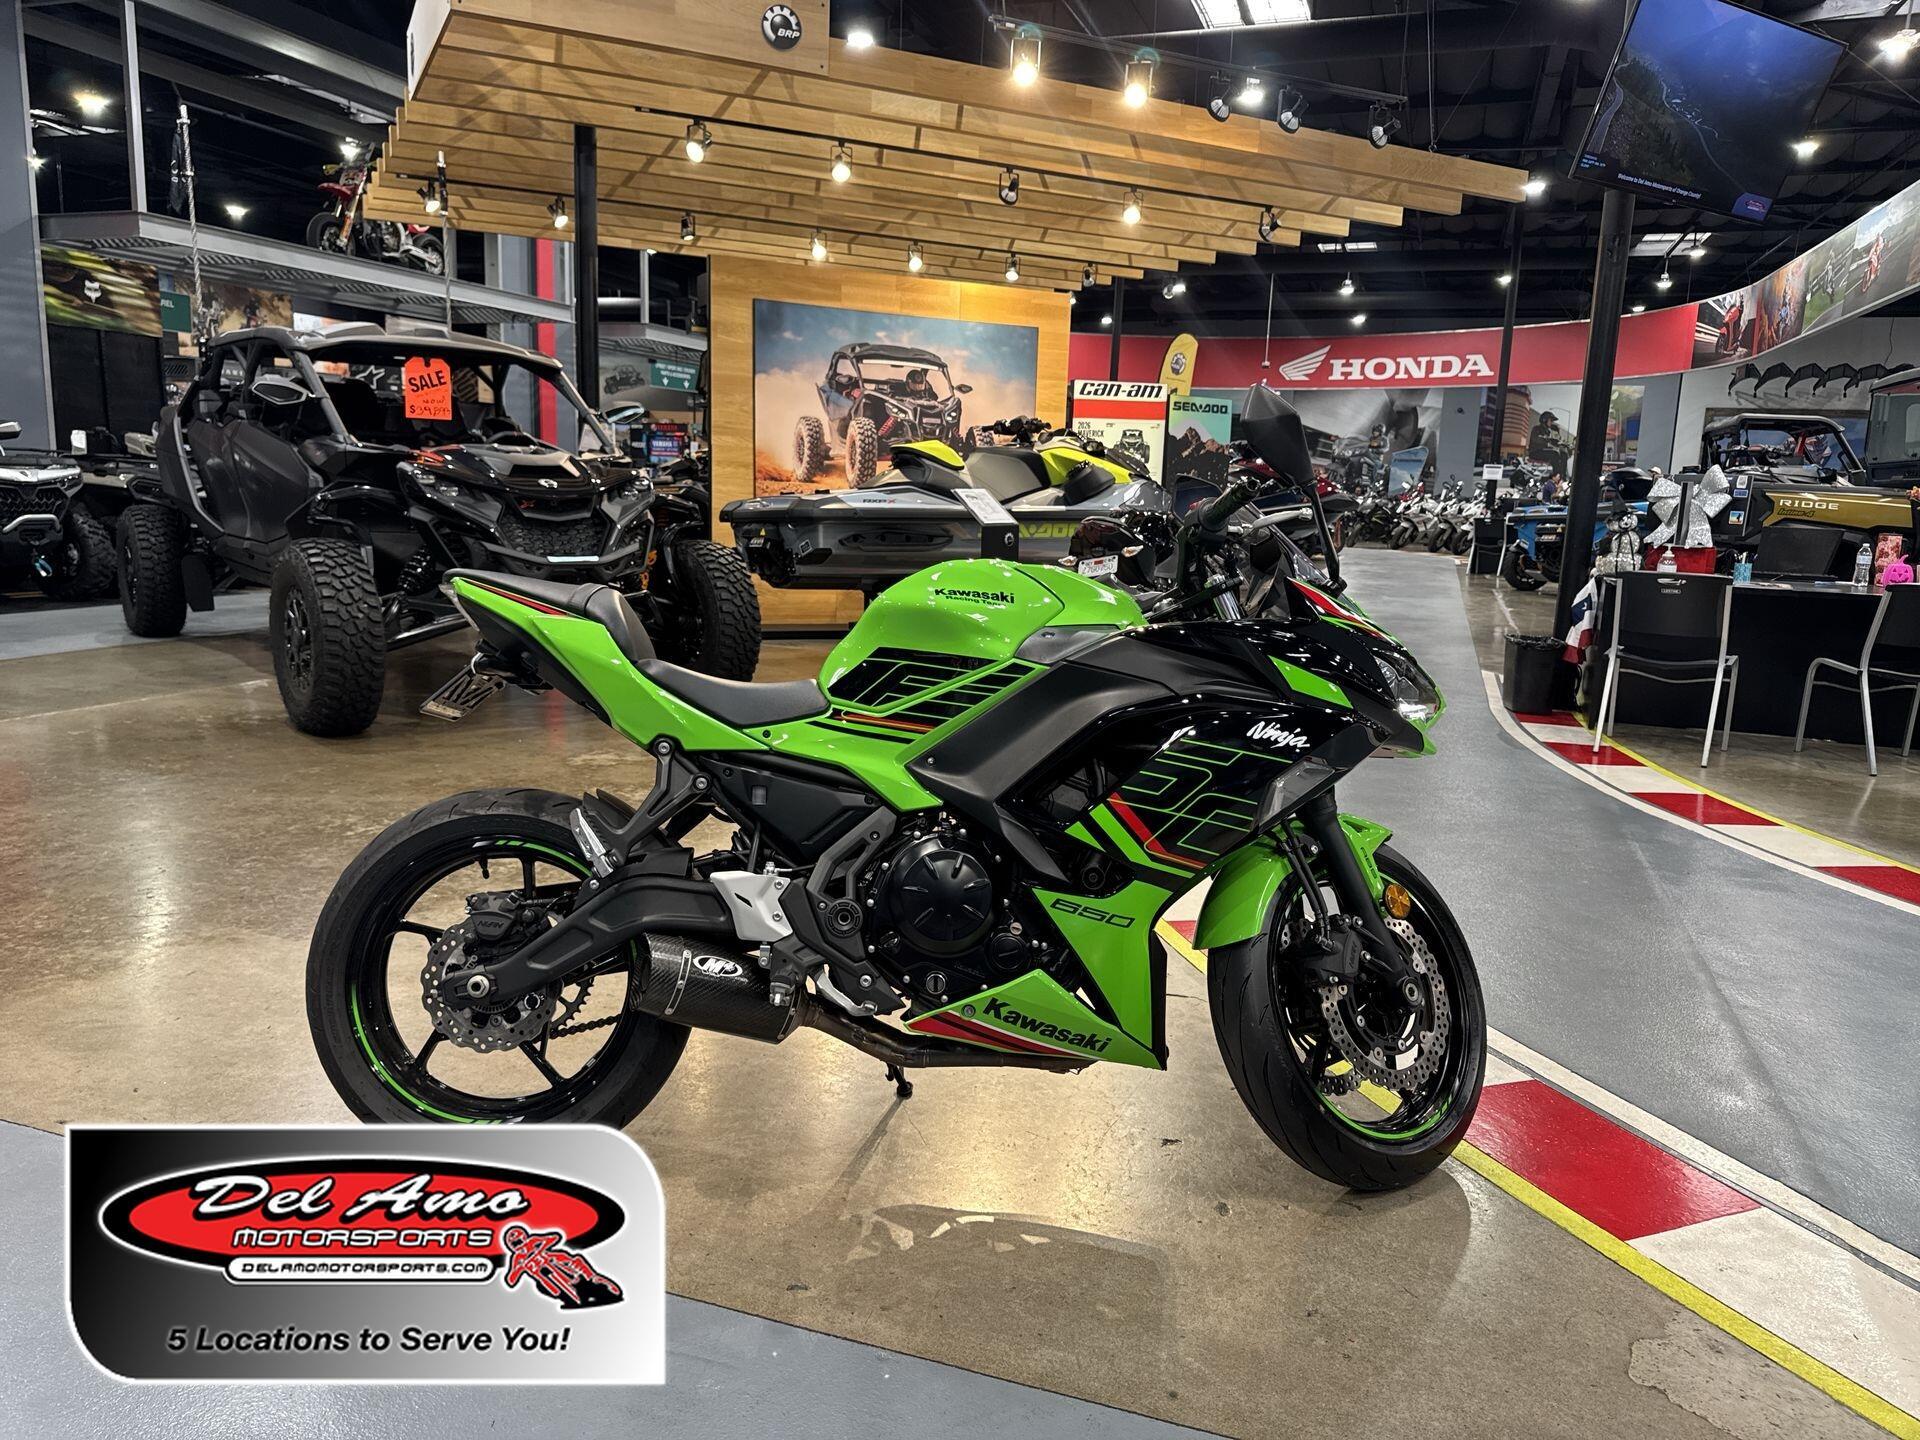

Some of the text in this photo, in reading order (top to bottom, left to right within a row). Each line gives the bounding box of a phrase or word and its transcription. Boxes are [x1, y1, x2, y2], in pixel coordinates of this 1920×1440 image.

[777, 28, 800, 38] BRP
[1328, 354, 1494, 380] HONDA
[408, 370, 447, 393] SALE
[1779, 499, 1840, 510] RIDGE
[934, 588, 1015, 604] Kawasaki
[945, 595, 980, 604] Racing
[1247, 721, 1310, 752] Ninja
[1050, 898, 1136, 928] 650
[982, 997, 1113, 1053] Kawasaki
